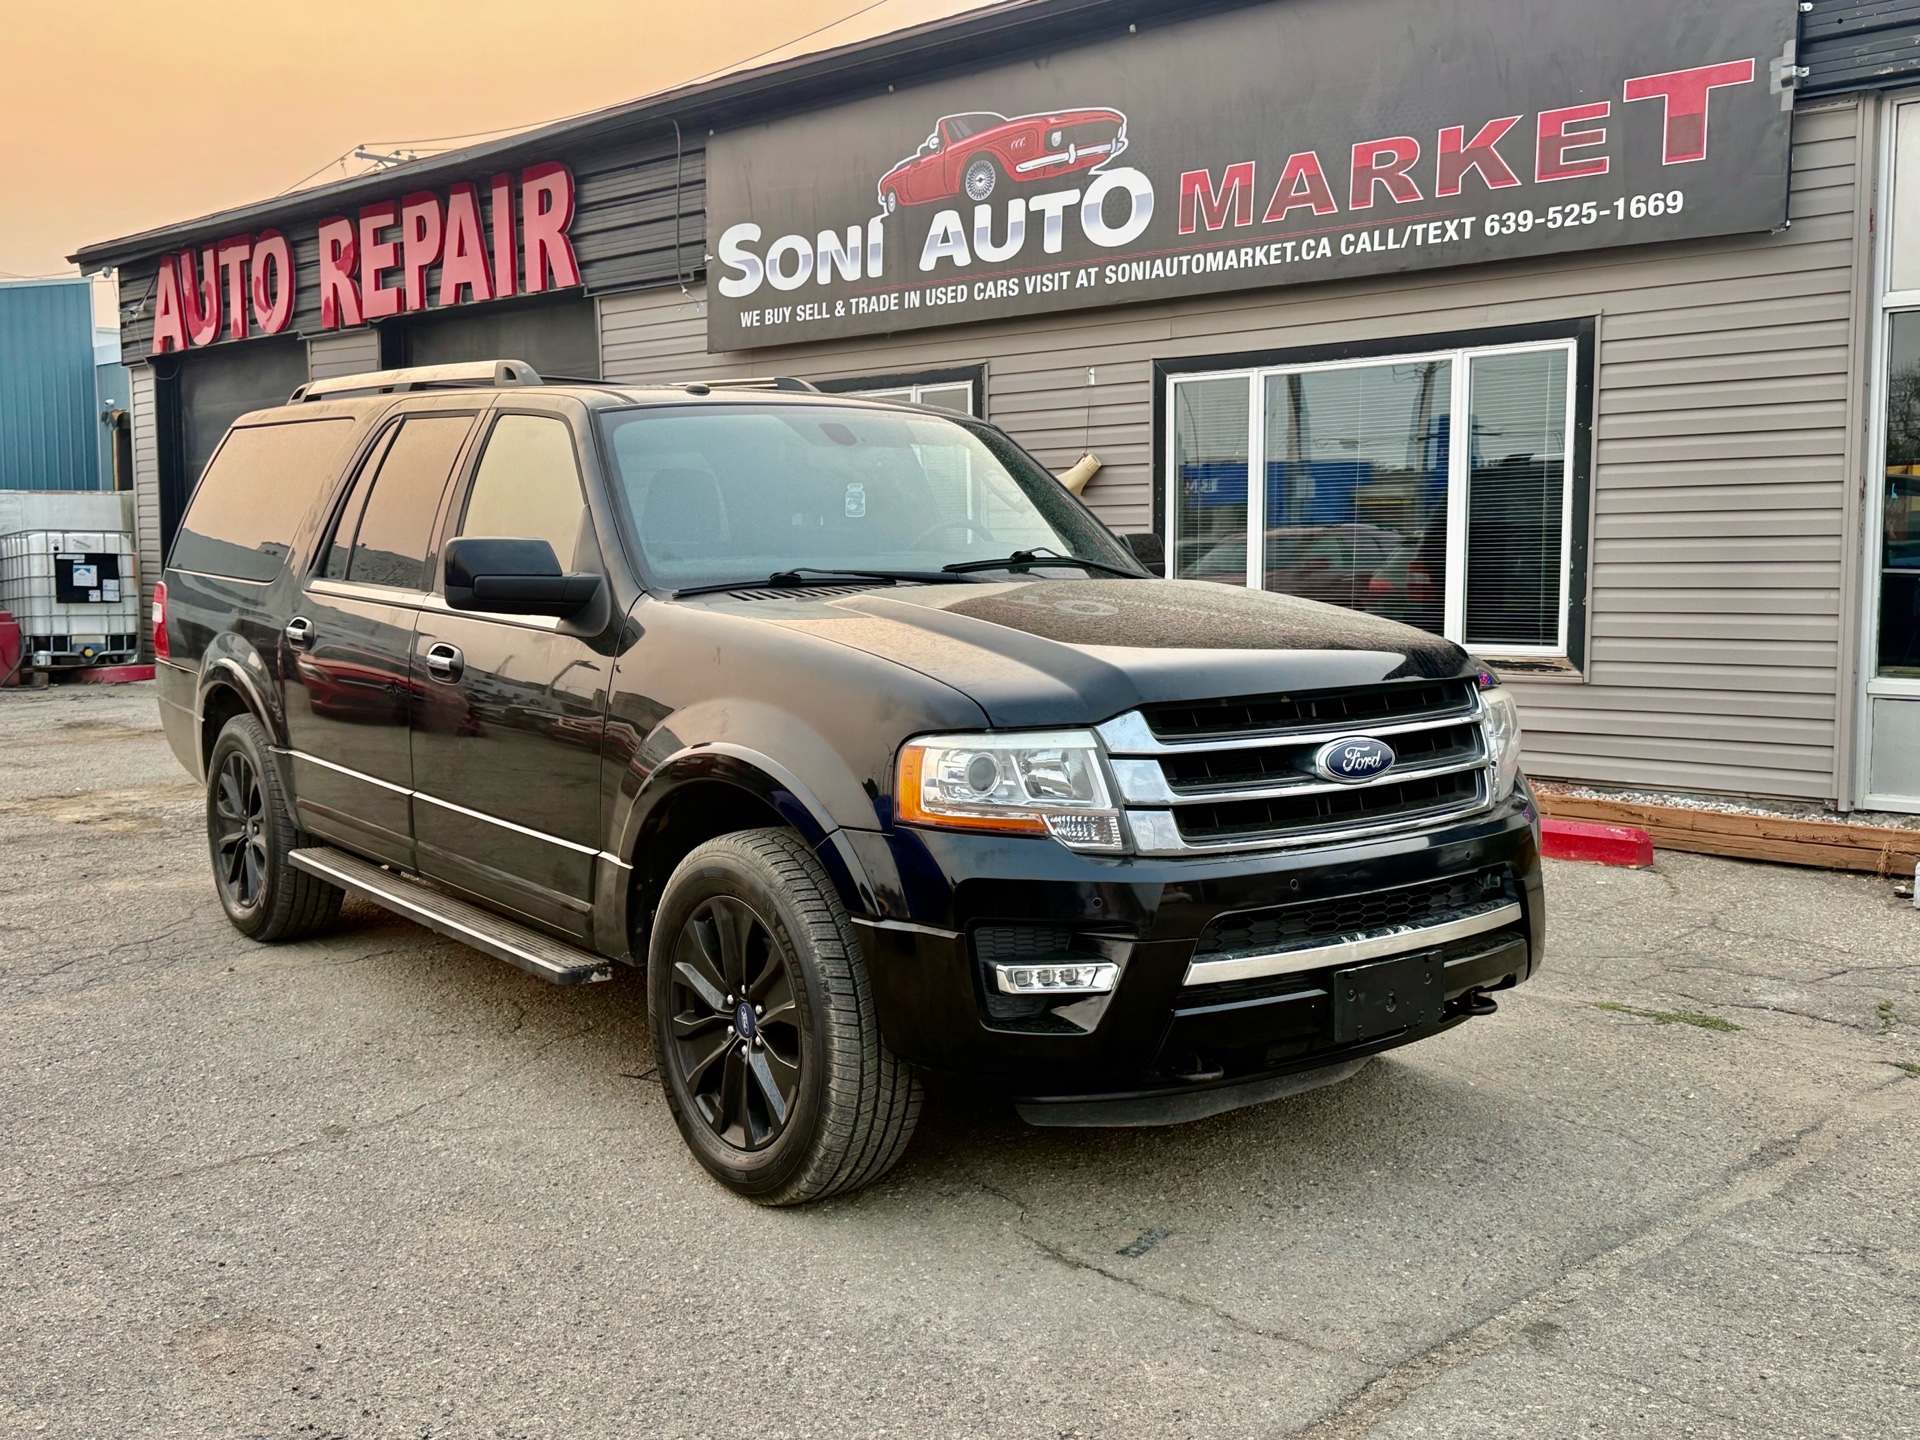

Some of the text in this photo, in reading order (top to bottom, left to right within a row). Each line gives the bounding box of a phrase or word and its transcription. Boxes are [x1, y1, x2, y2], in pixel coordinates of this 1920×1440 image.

[918, 166, 1155, 272] AUTO
[1177, 58, 1756, 236] MARKET
[152, 162, 582, 354] AUTO REPAIR
[739, 190, 1685, 328] WE BUY SELL & TRADE IN USED CARS VISIT AT SONIAUTOMARKET.CA CALL/TEXT 639-525-1669
[1342, 745, 1383, 773] Ford
